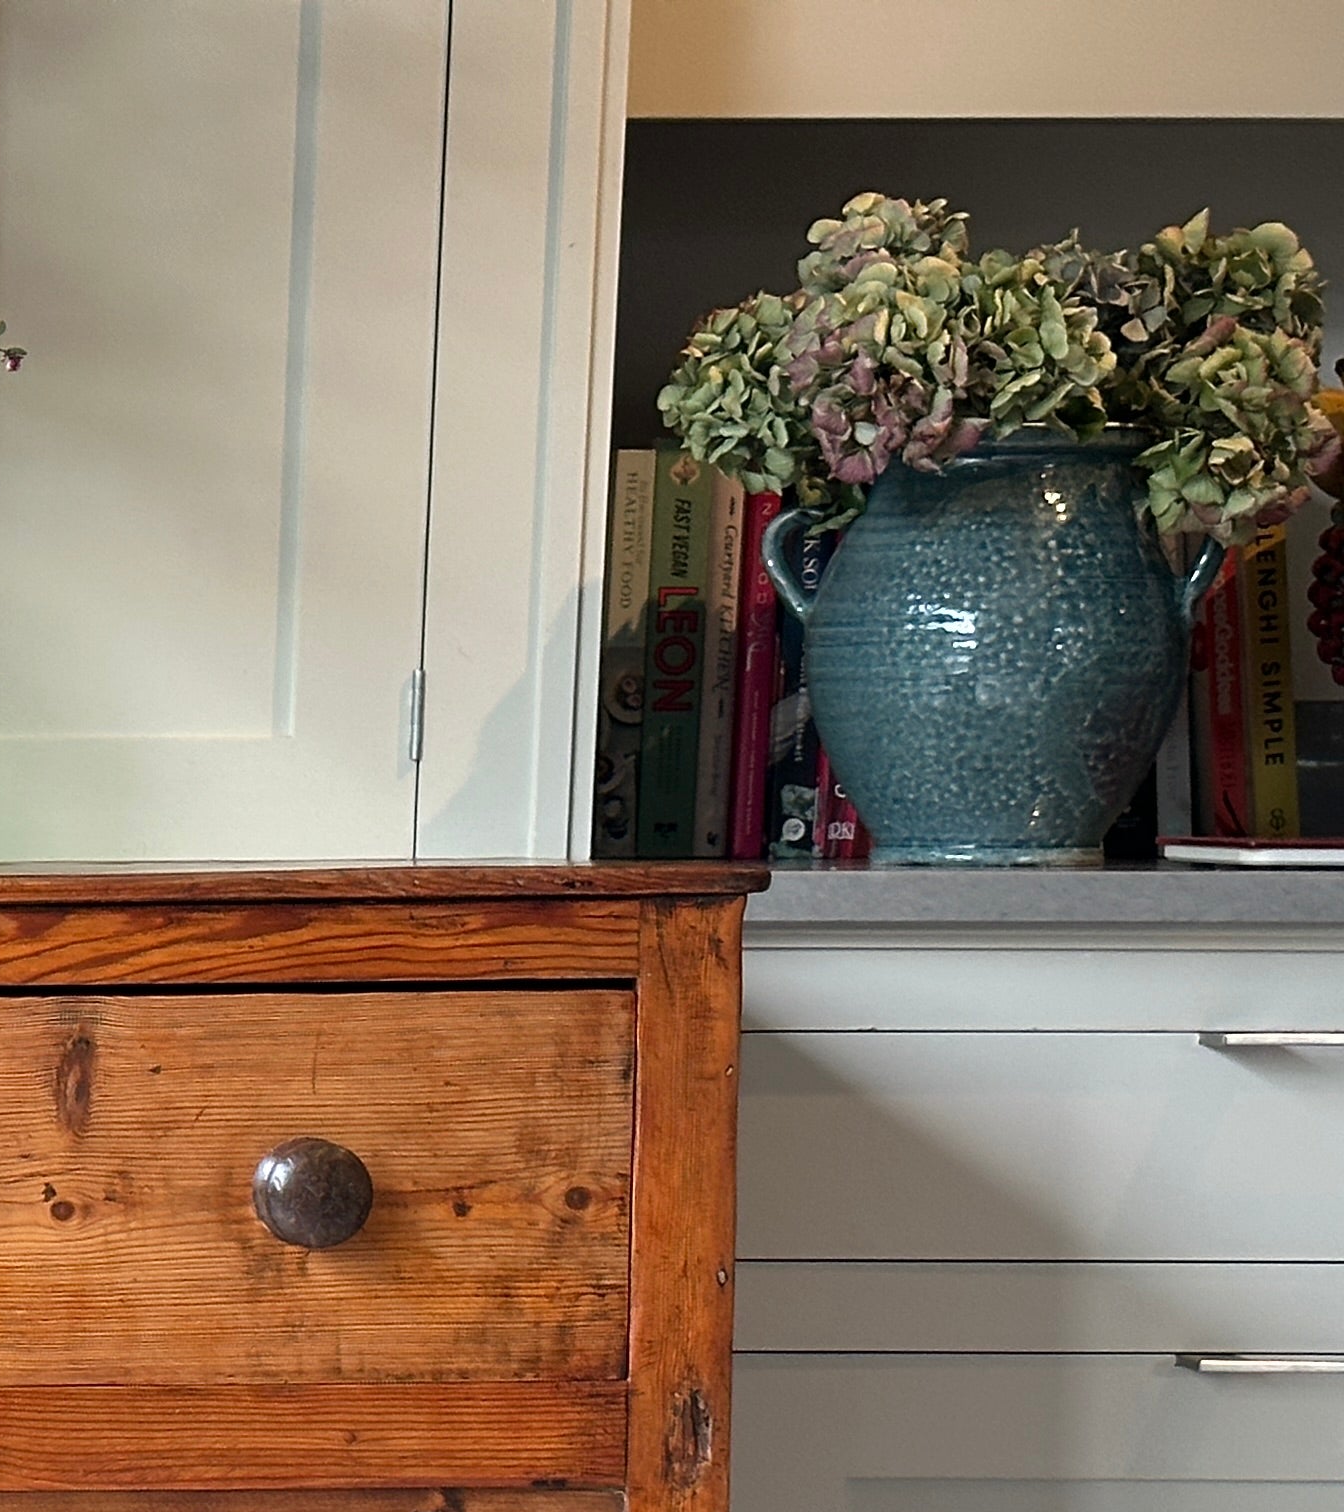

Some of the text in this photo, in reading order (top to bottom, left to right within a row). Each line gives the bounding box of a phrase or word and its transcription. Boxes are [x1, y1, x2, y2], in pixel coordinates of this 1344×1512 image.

[620, 472, 639, 609] HEALTHY FOOD
[670, 498, 693, 579] FAST VEGAN
[653, 587, 698, 712] LEON
[712, 524, 739, 693] Courtyard KITCHEN
[1260, 664, 1285, 767] SIMPLE
[827, 821, 856, 840] DK
